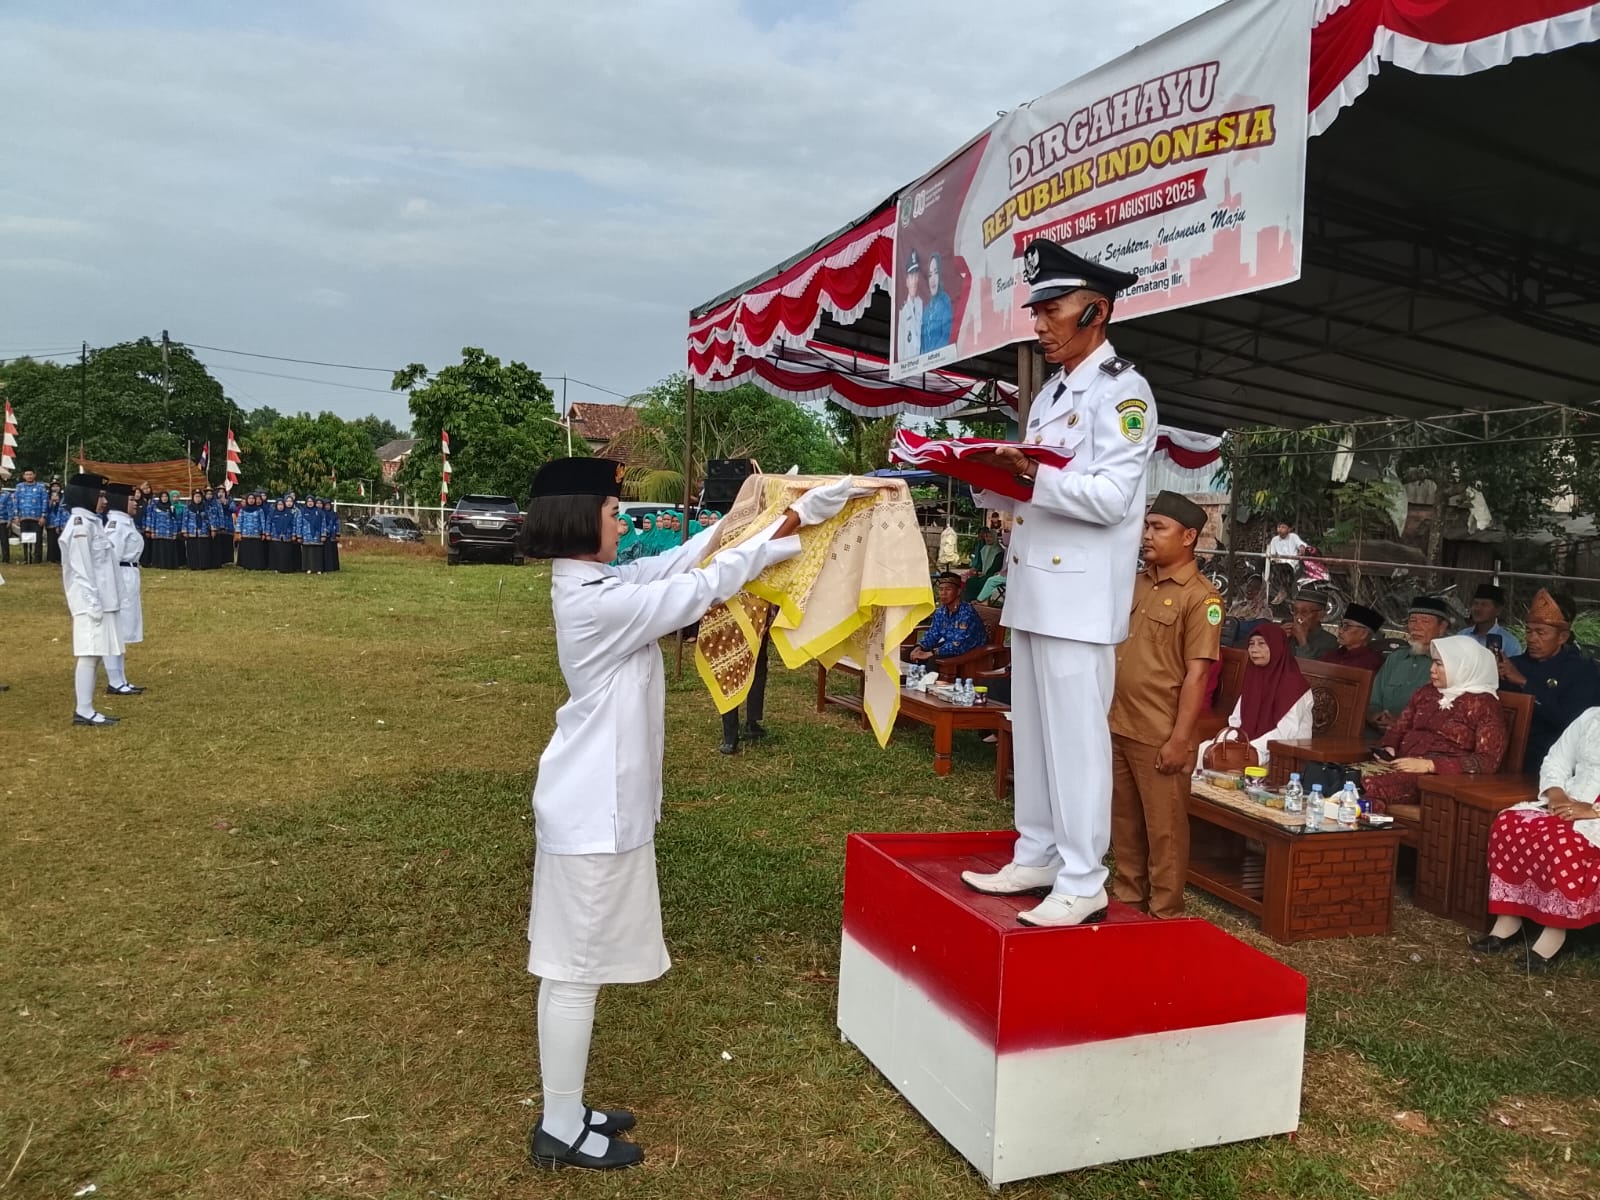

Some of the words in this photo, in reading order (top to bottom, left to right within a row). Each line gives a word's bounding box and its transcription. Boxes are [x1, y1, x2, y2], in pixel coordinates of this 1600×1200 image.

[1009, 61, 1220, 190] DIRGAHAYU
[982, 158, 1095, 249] REPUBLIK
[1096, 104, 1276, 187] INDONESIA
[1074, 213, 1097, 236] 1945
[1105, 207, 1117, 225] 17
[1118, 189, 1164, 224] AGUSTUS
[1165, 179, 1196, 208] 2025
[1105, 238, 1153, 262] Sejahtera,
[1158, 222, 1206, 245] Indonesia
[1210, 207, 1247, 230] Maju
[1126, 278, 1169, 296] Lematang
[1133, 259, 1168, 276] Penukal
